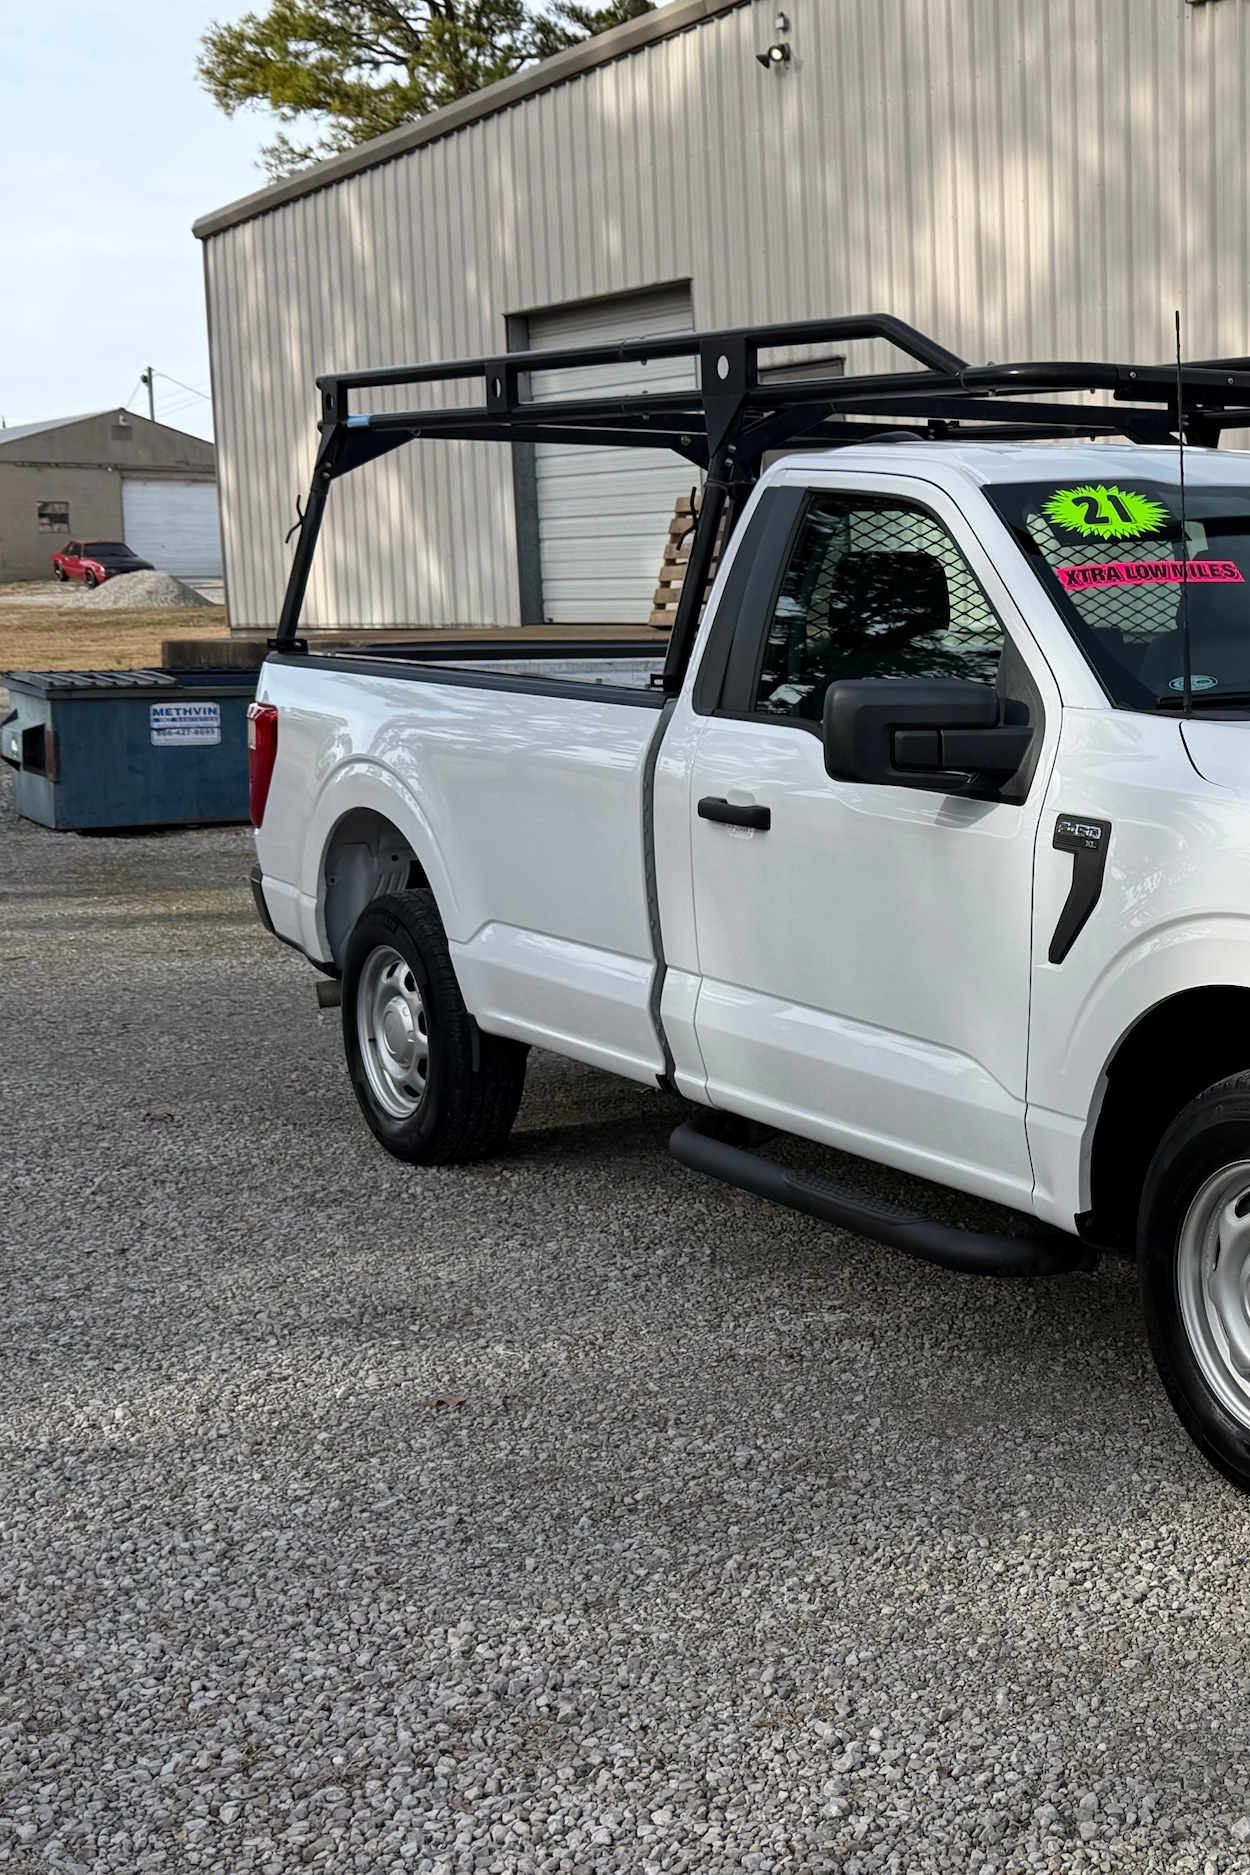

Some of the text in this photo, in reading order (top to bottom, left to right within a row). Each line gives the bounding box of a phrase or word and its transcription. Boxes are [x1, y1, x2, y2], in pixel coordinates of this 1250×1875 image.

[1071, 494, 1137, 526] 21
[1063, 562, 1237, 587] XTRA LOW MILES
[152, 707, 218, 716] METHVIN
